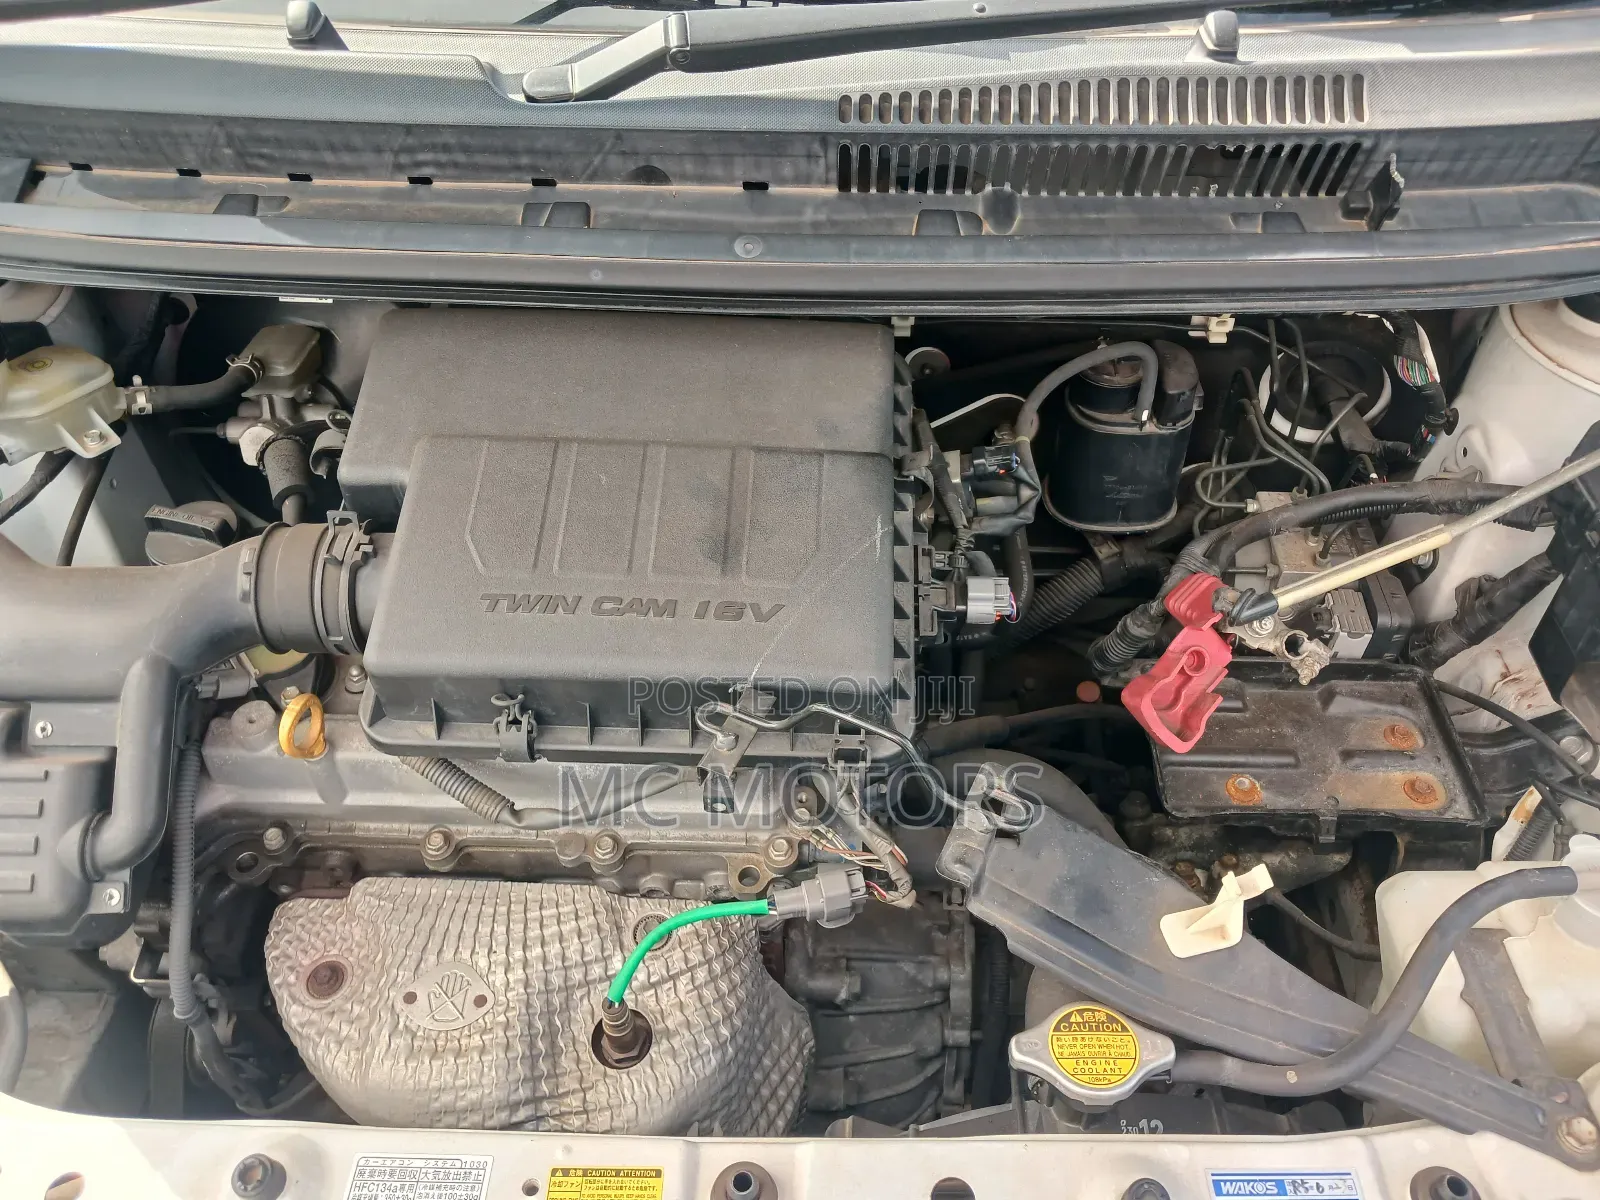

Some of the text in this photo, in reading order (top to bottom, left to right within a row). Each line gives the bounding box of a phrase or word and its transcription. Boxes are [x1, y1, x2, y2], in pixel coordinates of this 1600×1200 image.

[480, 593, 786, 623] TWIN CAM 16V
[1083, 1011, 1107, 1023] 危険
[1060, 1023, 1122, 1032] CAUTION
[1075, 1059, 1119, 1067] ENGINE
[1138, 1118, 1164, 1134] 12
[363, 1158, 457, 1168] カーエアコン システム
[463, 1160, 488, 1169] 1030
[355, 1168, 417, 1181] 廃棄時要回収
[420, 1169, 483, 1182] 大気放出禁止
[568, 1169, 583, 1177] 危険
[587, 1169, 656, 1178] CAUTION ATTENTION
[550, 1180, 582, 1189] 冷却ファン
